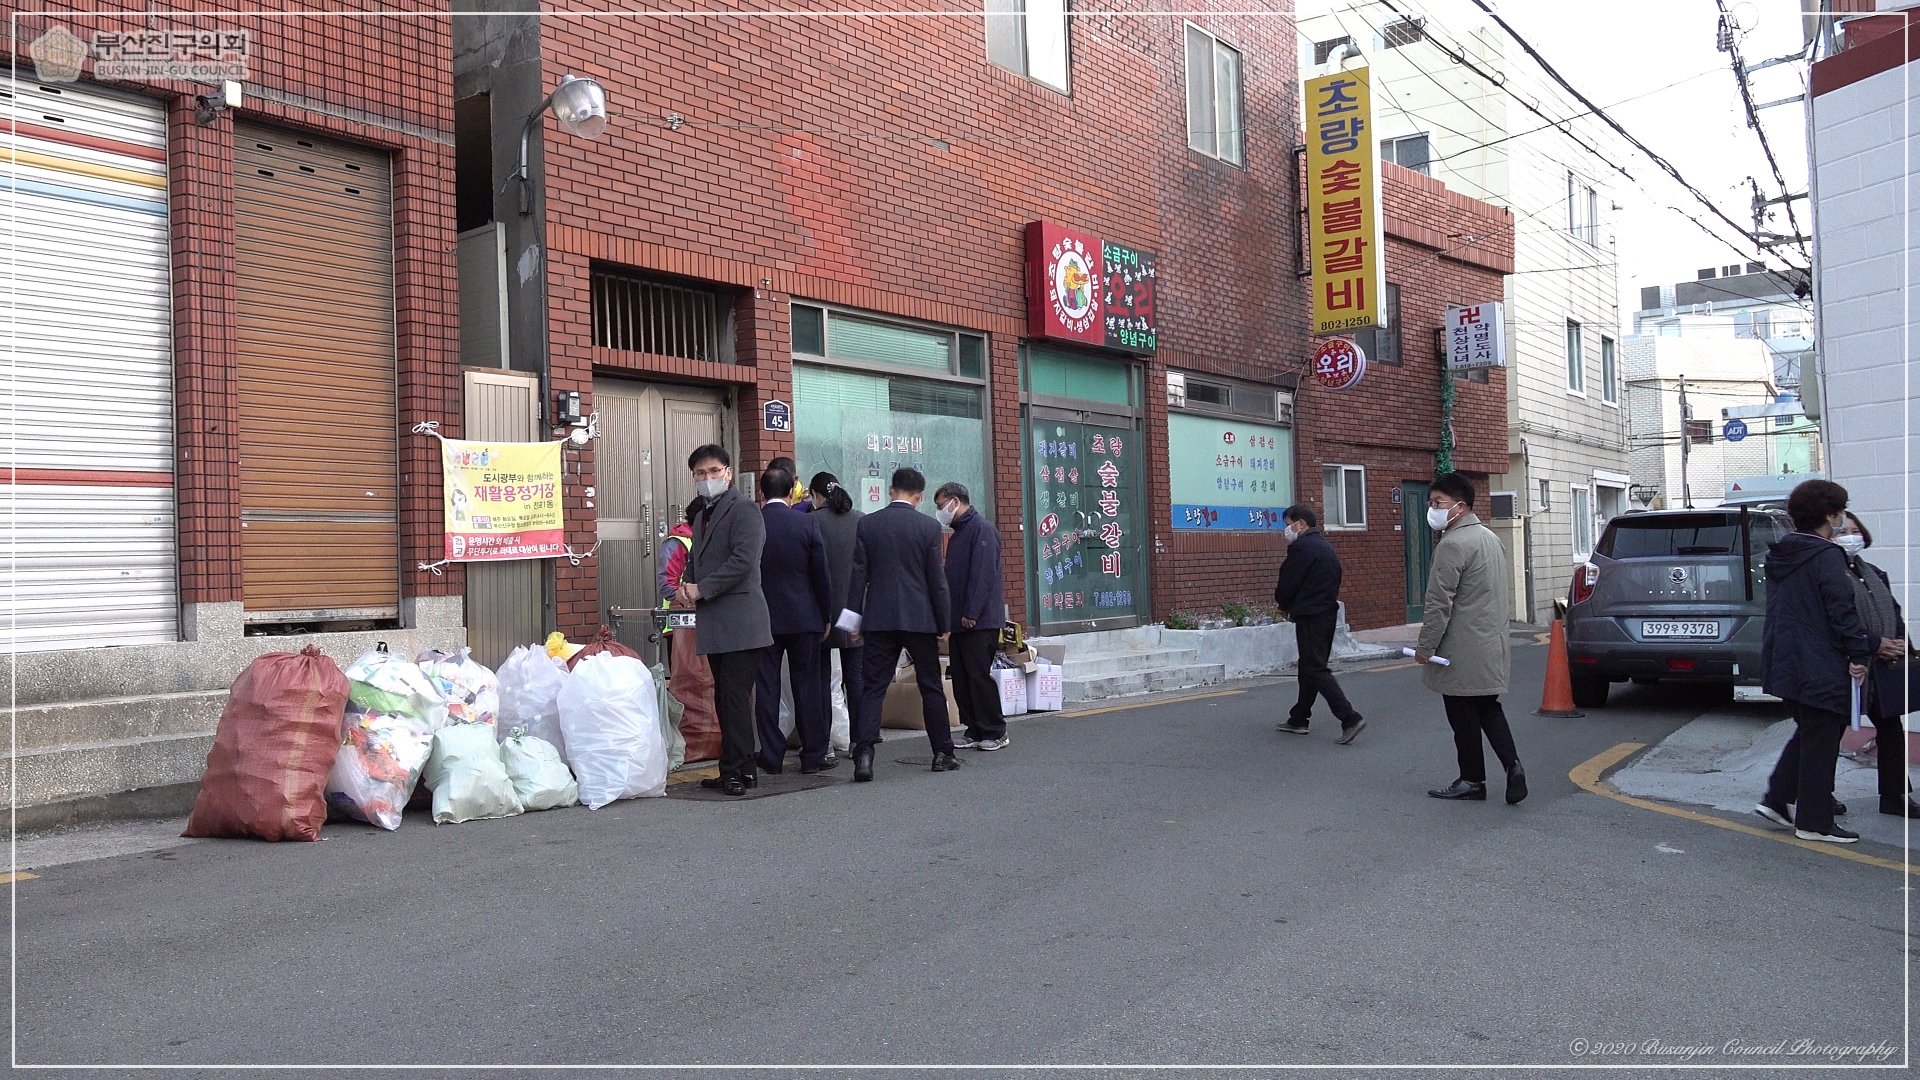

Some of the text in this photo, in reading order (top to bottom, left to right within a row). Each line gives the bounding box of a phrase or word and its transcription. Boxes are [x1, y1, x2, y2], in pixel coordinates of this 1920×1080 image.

[1104, 245, 1138, 268] 소금구이
[1106, 272, 1154, 326] 오리
[1321, 315, 1371, 331] 802-1250
[1120, 329, 1155, 350] 양념구이
[1453, 326, 1470, 362] 천상선녀
[1317, 351, 1353, 373] 오리
[771, 415, 783, 428] 45
[1727, 426, 1744, 436] ADT
[867, 434, 923, 454] 돼지갈비
[1092, 434, 1122, 457] 초량
[1216, 454, 1243, 468] 소금구이
[483, 471, 555, 483] 도시광부와 함께하는
[1217, 476, 1244, 492] 양념구이
[474, 482, 556, 503] 재활용정거장
[1041, 514, 1058, 533] 오리
[1097, 460, 1123, 578] 숯불갈비
[468, 536, 495, 547] 운영시간
[1042, 528, 1081, 560] 소금구이
[1044, 551, 1083, 585] 양념구이
[1042, 591, 1084, 611] 예약문의
[1682, 623, 1714, 635] 9378
